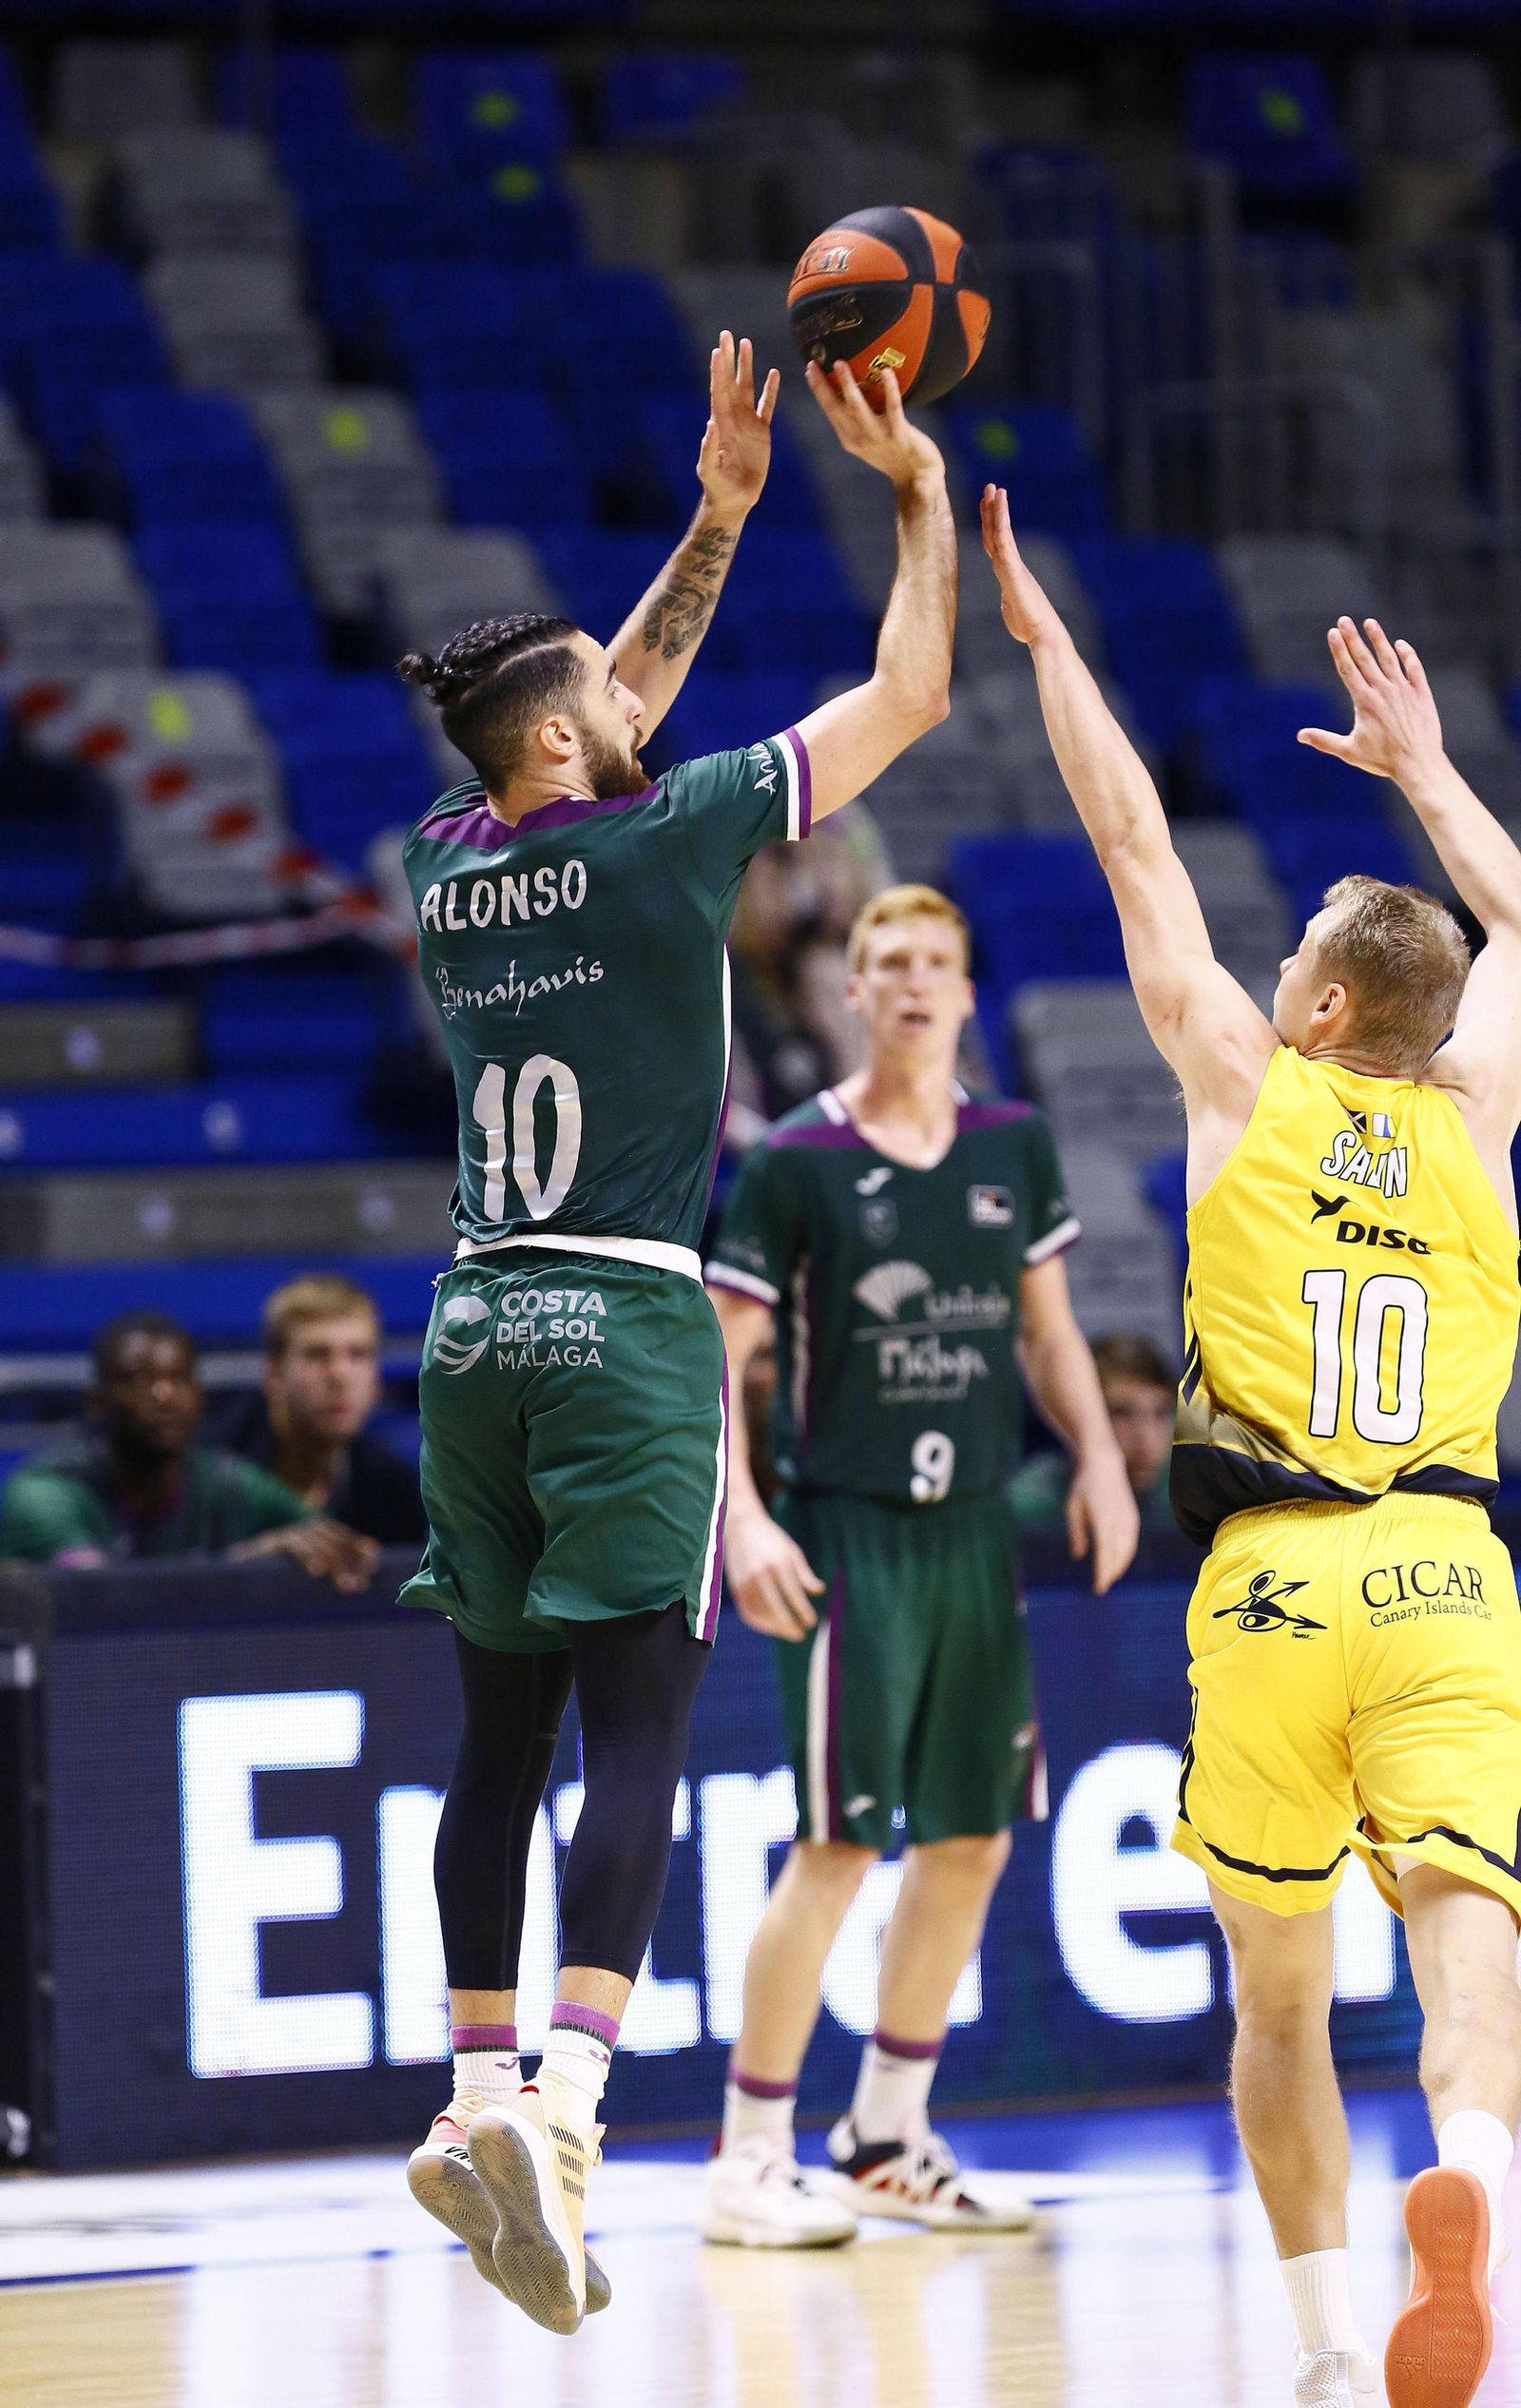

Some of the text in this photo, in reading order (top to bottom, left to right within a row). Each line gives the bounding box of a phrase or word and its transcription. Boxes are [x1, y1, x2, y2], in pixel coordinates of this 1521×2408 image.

[420, 858, 587, 933] ALONSO
[472, 1053, 582, 1222] 10
[500, 1289, 607, 1317] COSTA
[495, 1319, 606, 1343] DEL SOL
[496, 1342, 604, 1370] MÁLAGA
[1301, 1269, 1429, 1445] 10
[910, 1430, 955, 1504] 9
[1361, 1560, 1488, 1609] CICAR
[1370, 1599, 1492, 1628] Canary Islands Car
